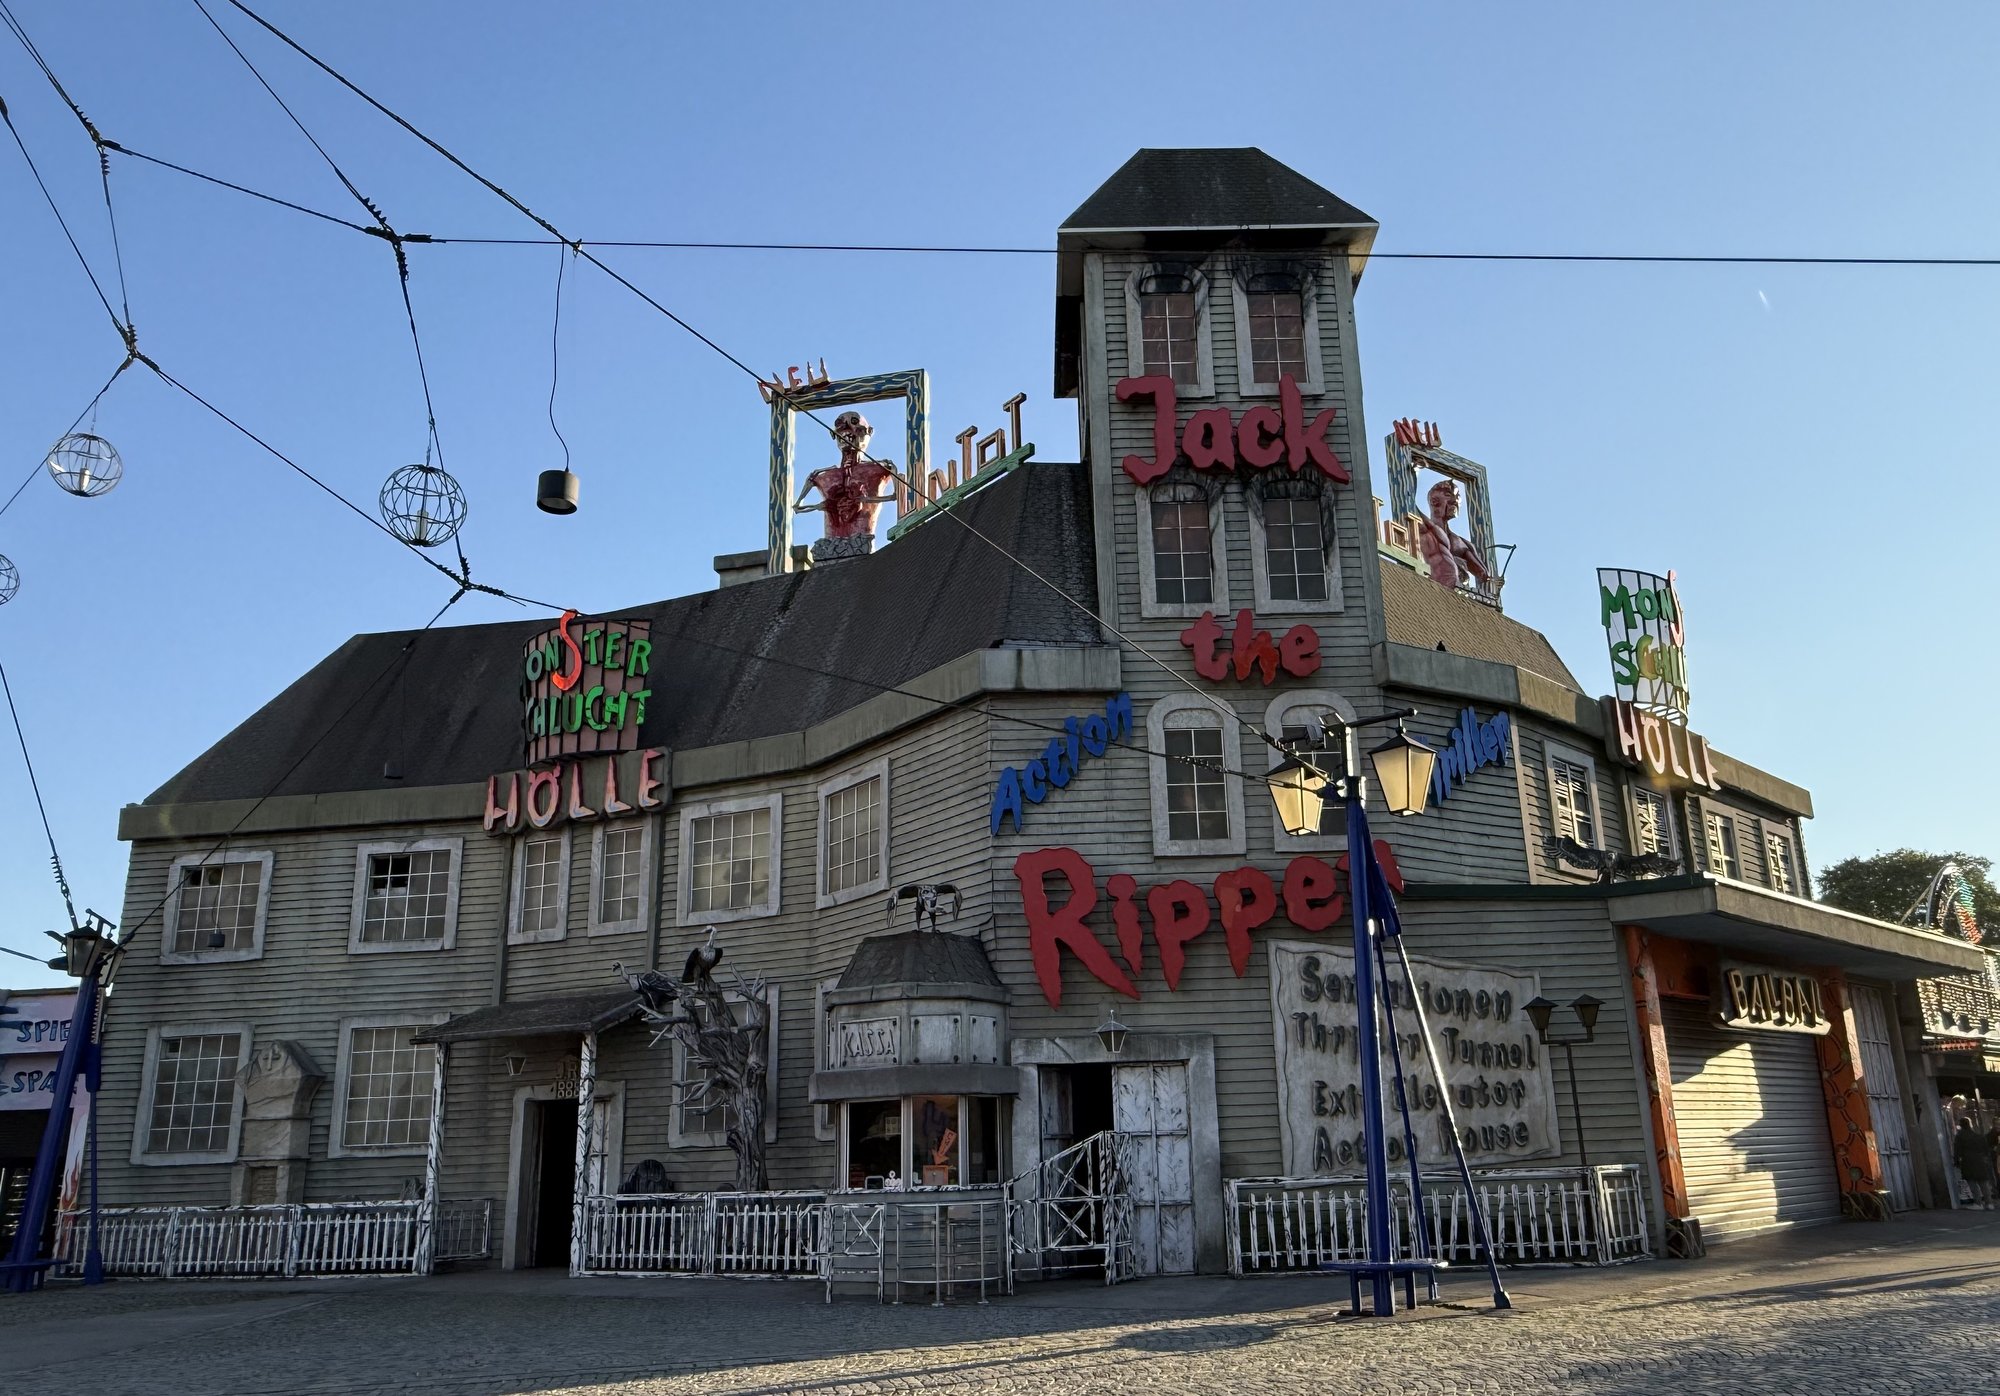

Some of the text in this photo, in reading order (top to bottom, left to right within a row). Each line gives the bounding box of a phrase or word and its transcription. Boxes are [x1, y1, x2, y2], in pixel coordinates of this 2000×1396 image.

[1115, 373, 1349, 485] Jack
[521, 608, 652, 691] ONSTER
[1180, 608, 1321, 685] the
[521, 686, 652, 742] CHLUCHT
[990, 691, 1133, 837] Action
[843, 1027, 896, 1058] KASSA
[1441, 1027, 1537, 1071] Tunnel
[1312, 1126, 1418, 1172] Acton
